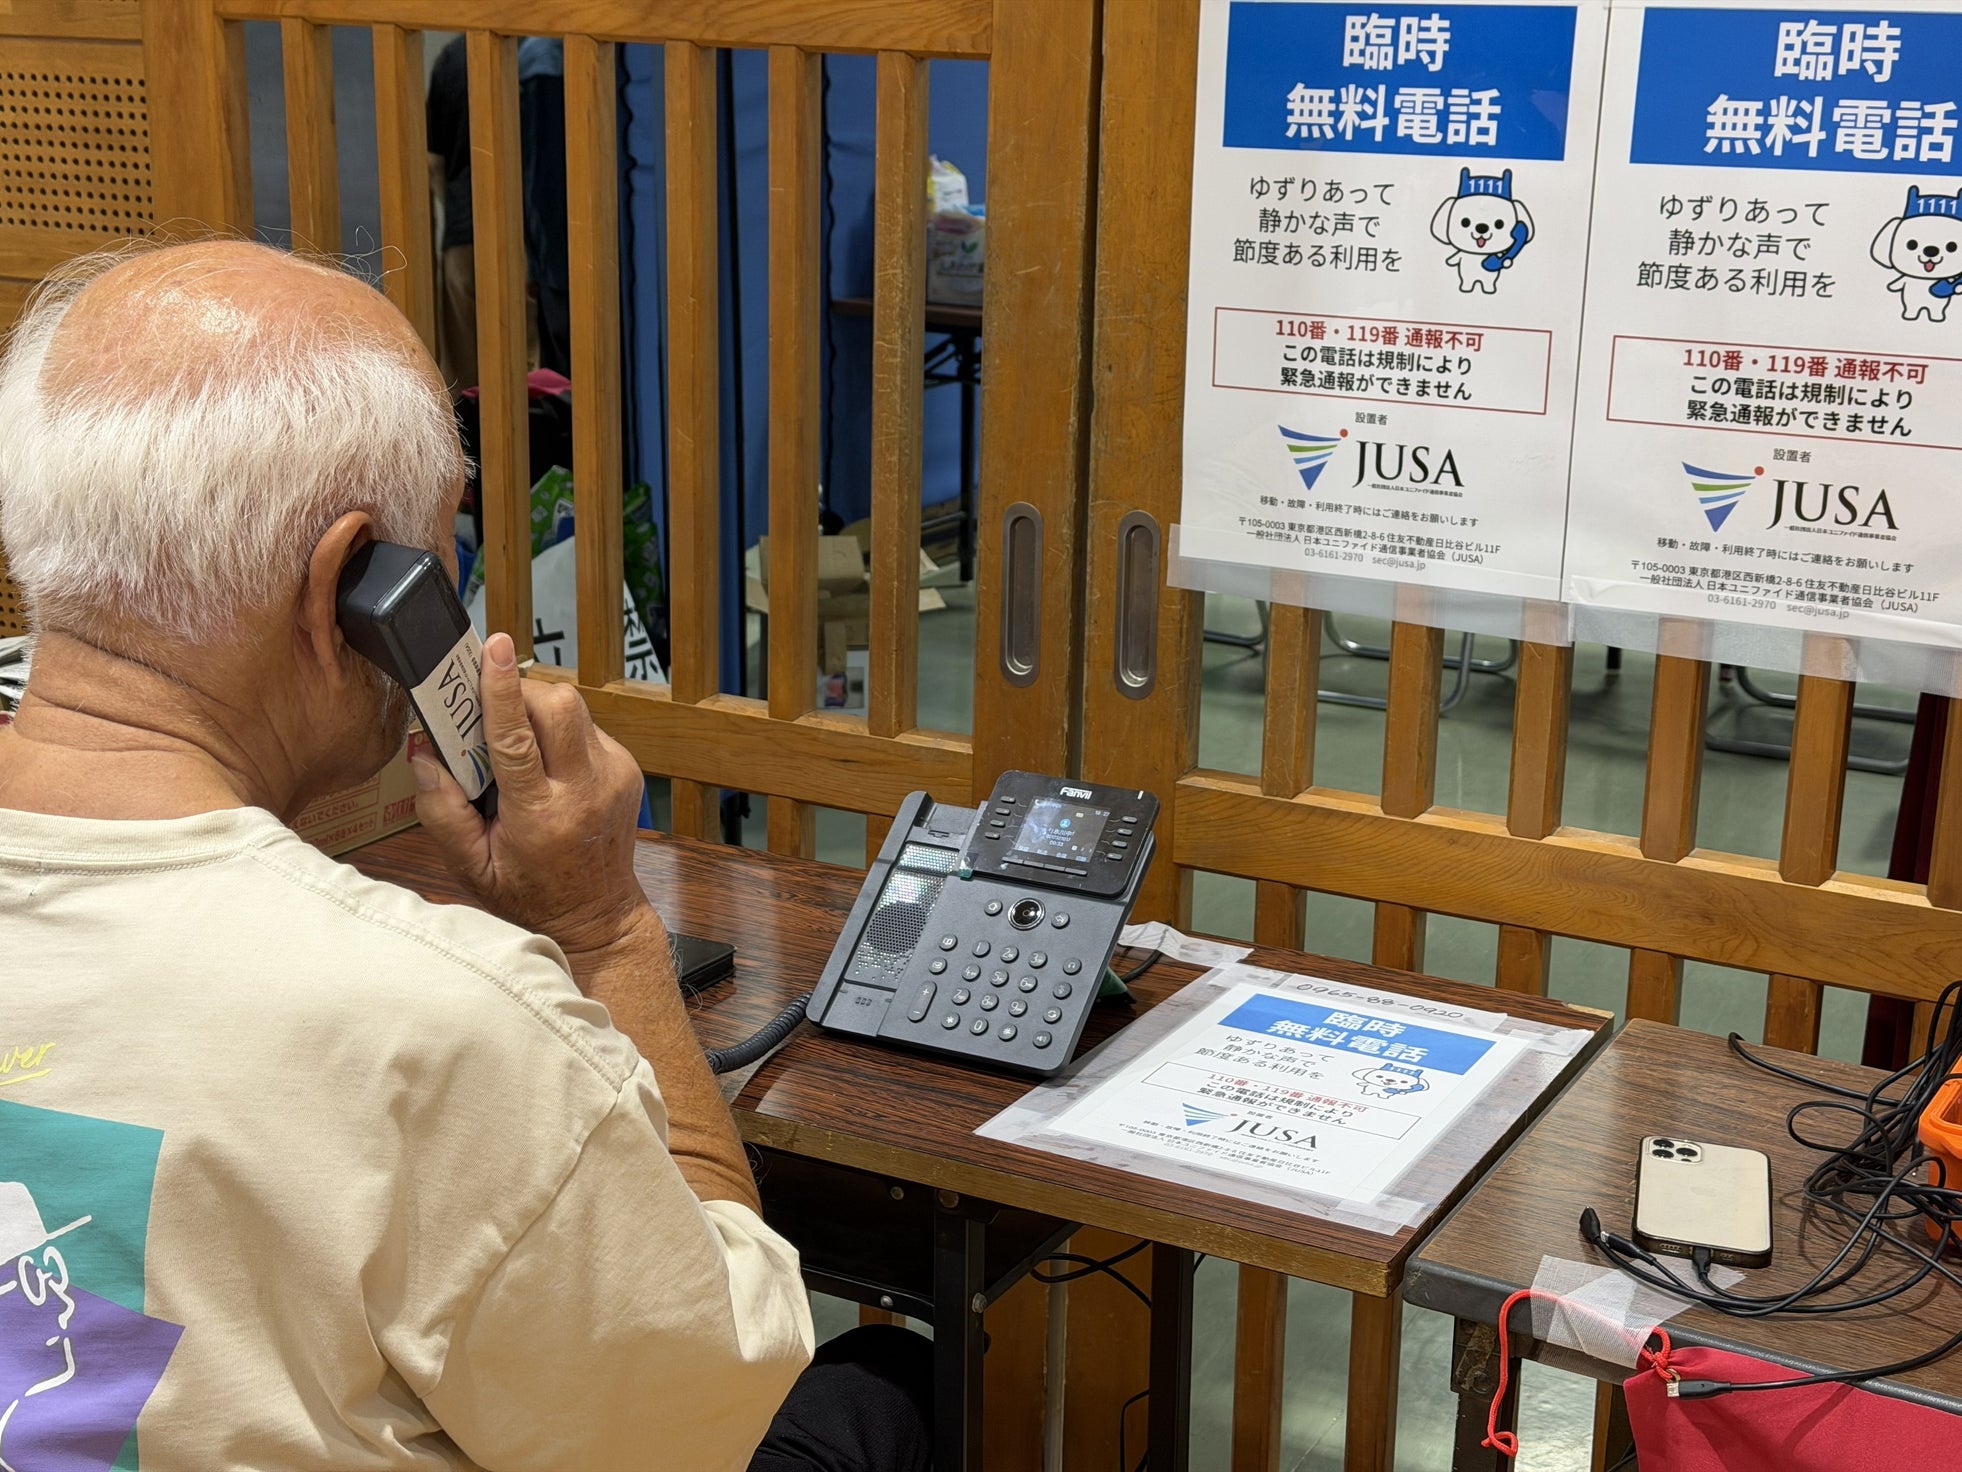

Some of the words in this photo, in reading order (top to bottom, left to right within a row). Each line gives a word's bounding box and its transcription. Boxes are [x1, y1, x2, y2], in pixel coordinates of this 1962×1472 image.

[1342, 13, 1451, 72] 臨時
[1774, 19, 1901, 83] 臨時
[1285, 82, 1501, 146] 無料電話
[1703, 93, 1958, 162] 無料電話
[1249, 176, 1395, 206] ゆずりあって
[1258, 207, 1380, 238] 静かな声で
[1659, 194, 1830, 227] ゆずりあって
[1232, 238, 1402, 273] 節度ある利用を
[1667, 228, 1811, 261] 静かな声で
[1636, 260, 1837, 299] 節度ある利用を
[1404, 326, 1484, 352] 通報不可
[1282, 344, 1473, 375] この電話は規制により
[1834, 357, 1928, 385] 通報不可
[1280, 366, 1472, 400] 緊急通報ができません
[1690, 374, 1913, 410] この電話は規制により
[1354, 412, 1388, 426] 設置者
[1686, 399, 1912, 437] 緊急通報ができません
[1352, 440, 1465, 489] JUSA
[1772, 448, 1812, 464] 設置者
[1766, 479, 1900, 531] JUSA
[1304, 547, 1364, 562] 03-6161-2970
[1372, 555, 1426, 571] sec@jusa.jp
[1707, 593, 1776, 610] 03-6161-2970
[1786, 603, 1850, 619] sec@jusa.jp
[438, 658, 482, 742] JUSA
[1060, 786, 1093, 800] Fanvil
[1296, 983, 1464, 1019] 0965-88-0920
[1266, 1019, 1430, 1063] 無料電話
[1322, 1011, 1407, 1039] 臨時
[1194, 1047, 1324, 1080] 節度ある利用を
[1223, 1044, 1316, 1068] 静かな声で
[1225, 1034, 1335, 1063] ゆずりあって
[1196, 1087, 1347, 1125] 緊急通報ができません
[1206, 1081, 1354, 1118] この電話は規制により
[1224, 1118, 1318, 1149] JUSA
